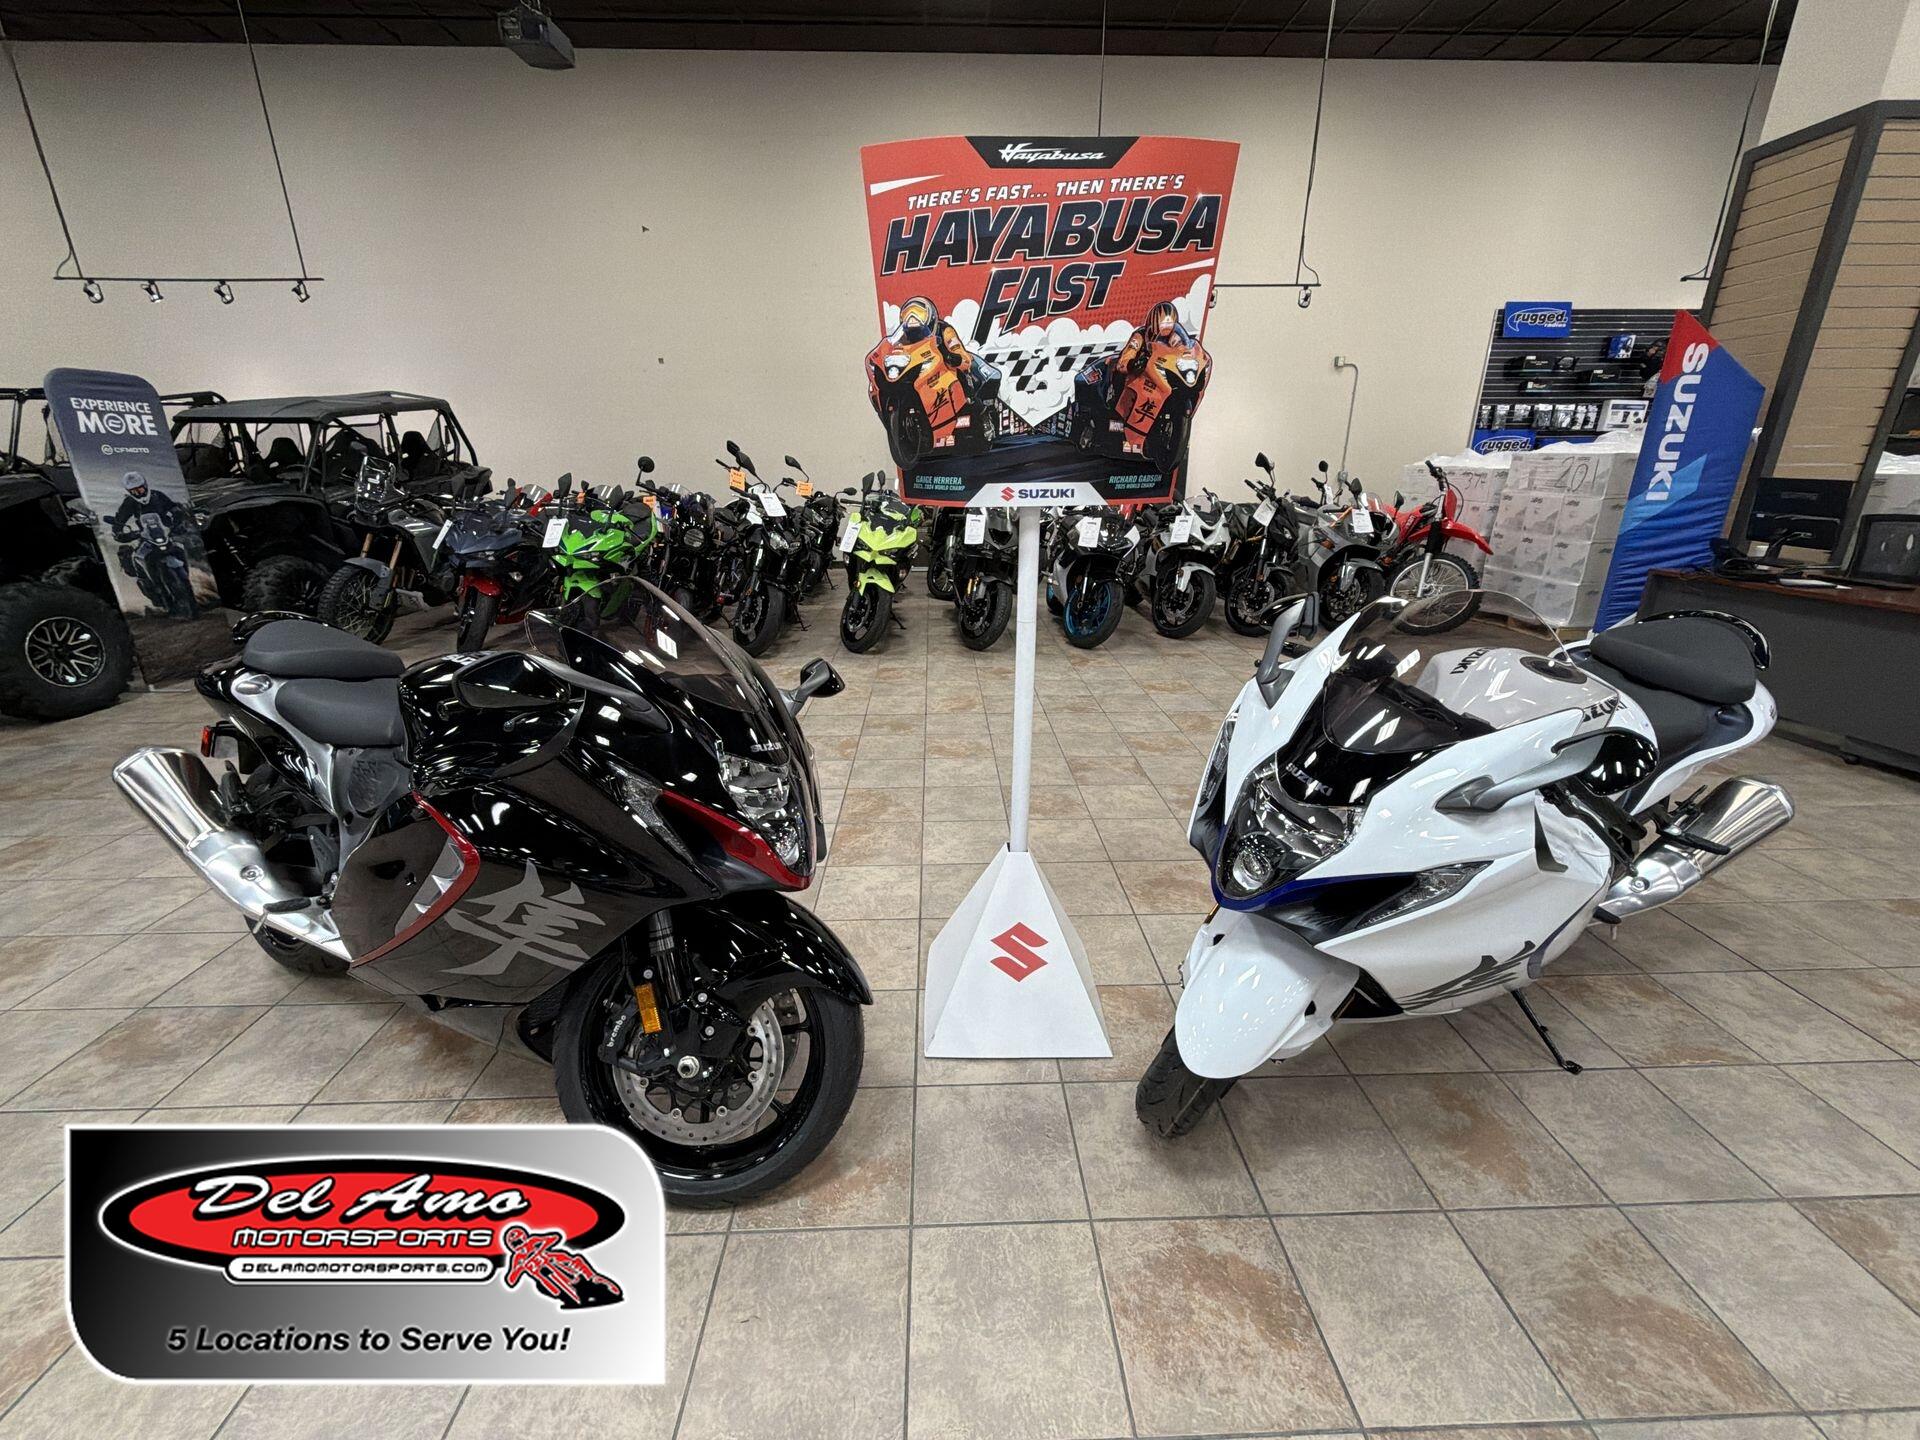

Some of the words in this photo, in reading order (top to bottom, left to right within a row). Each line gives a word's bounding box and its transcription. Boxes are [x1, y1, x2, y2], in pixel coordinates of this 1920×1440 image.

[998, 142, 1107, 164] Hayabusa
[908, 187, 981, 210] THERE'S
[985, 184, 1048, 201] FAST...
[1056, 179, 1104, 197] THEN
[1110, 174, 1185, 193] THERE'S
[880, 194, 1222, 277] HAYABUSA
[970, 260, 1127, 346] FAST
[70, 397, 152, 414] EXPERIENCE
[76, 410, 159, 436] MORE
[1645, 342, 1710, 501] SUZUKI
[114, 446, 150, 454] CFMOTO
[1108, 475, 1138, 484] RICHARD
[1018, 488, 1075, 499] SUZUKI
[606, 1014, 627, 1048] brembo
